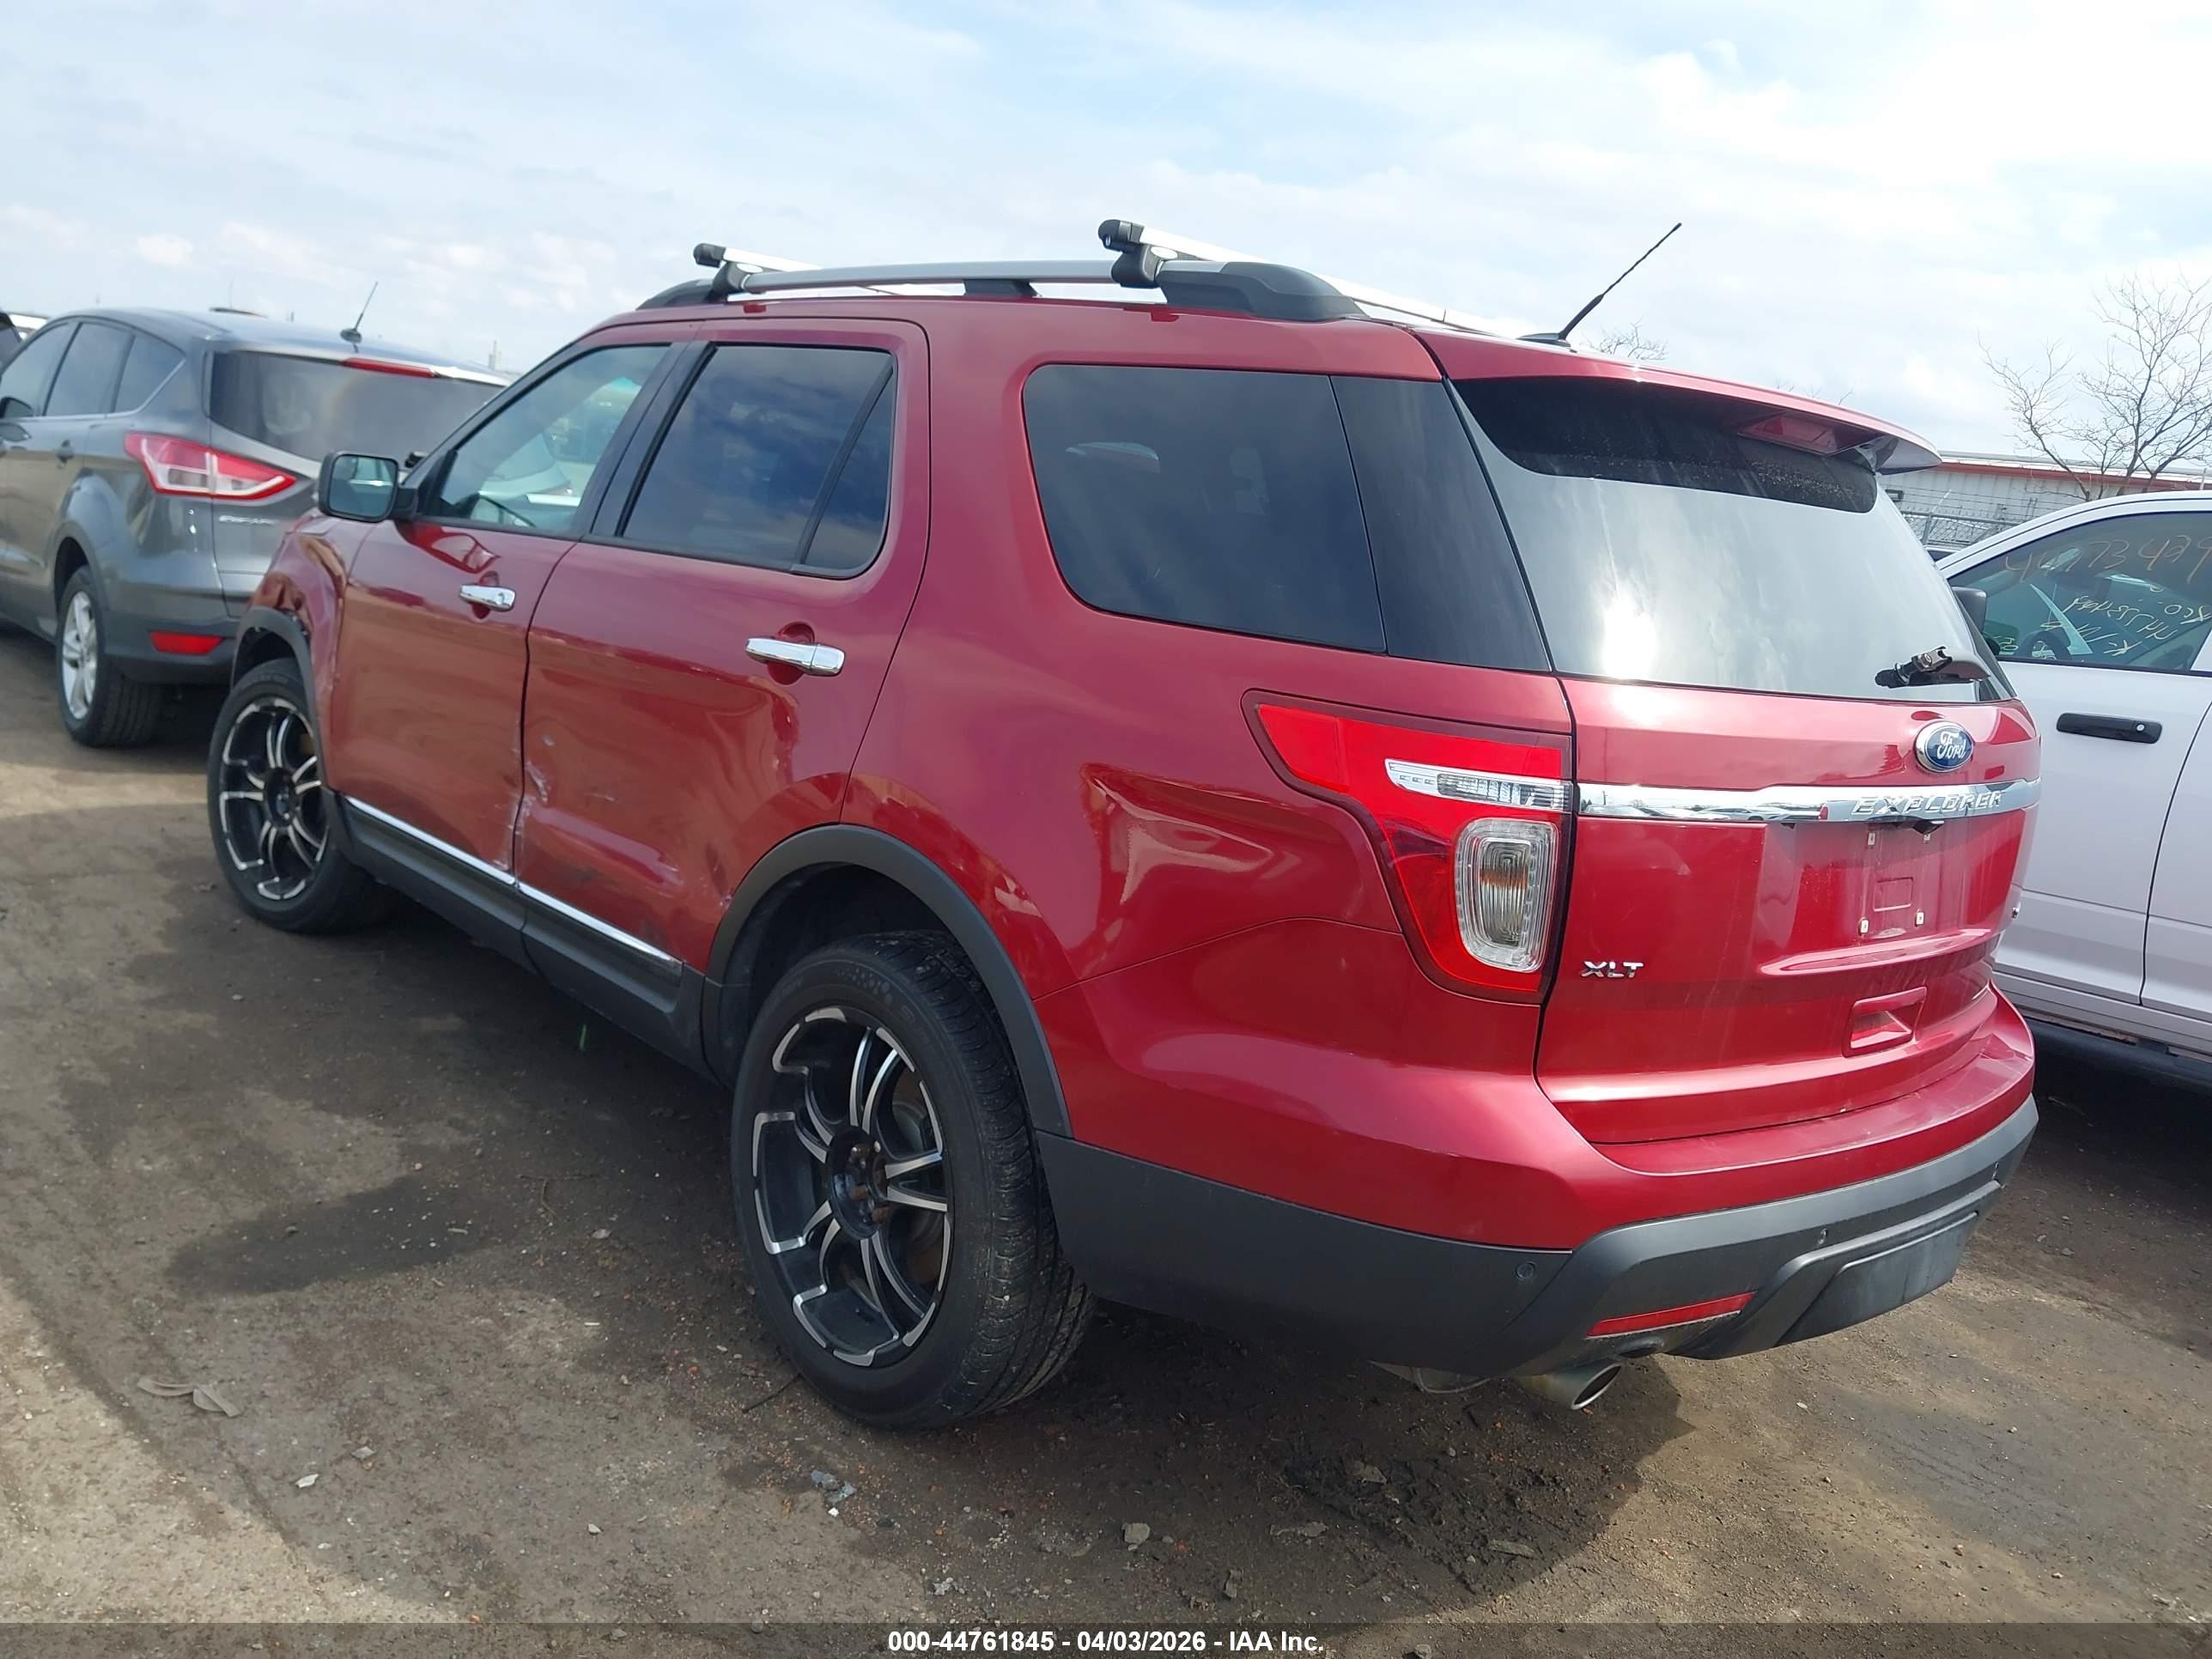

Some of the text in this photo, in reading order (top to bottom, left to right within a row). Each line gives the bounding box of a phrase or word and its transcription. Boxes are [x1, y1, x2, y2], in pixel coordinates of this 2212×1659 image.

[1937, 732, 1966, 760] Ford
[1851, 791, 2002, 816] EXPLORER
[1580, 961, 1644, 978] XLT
